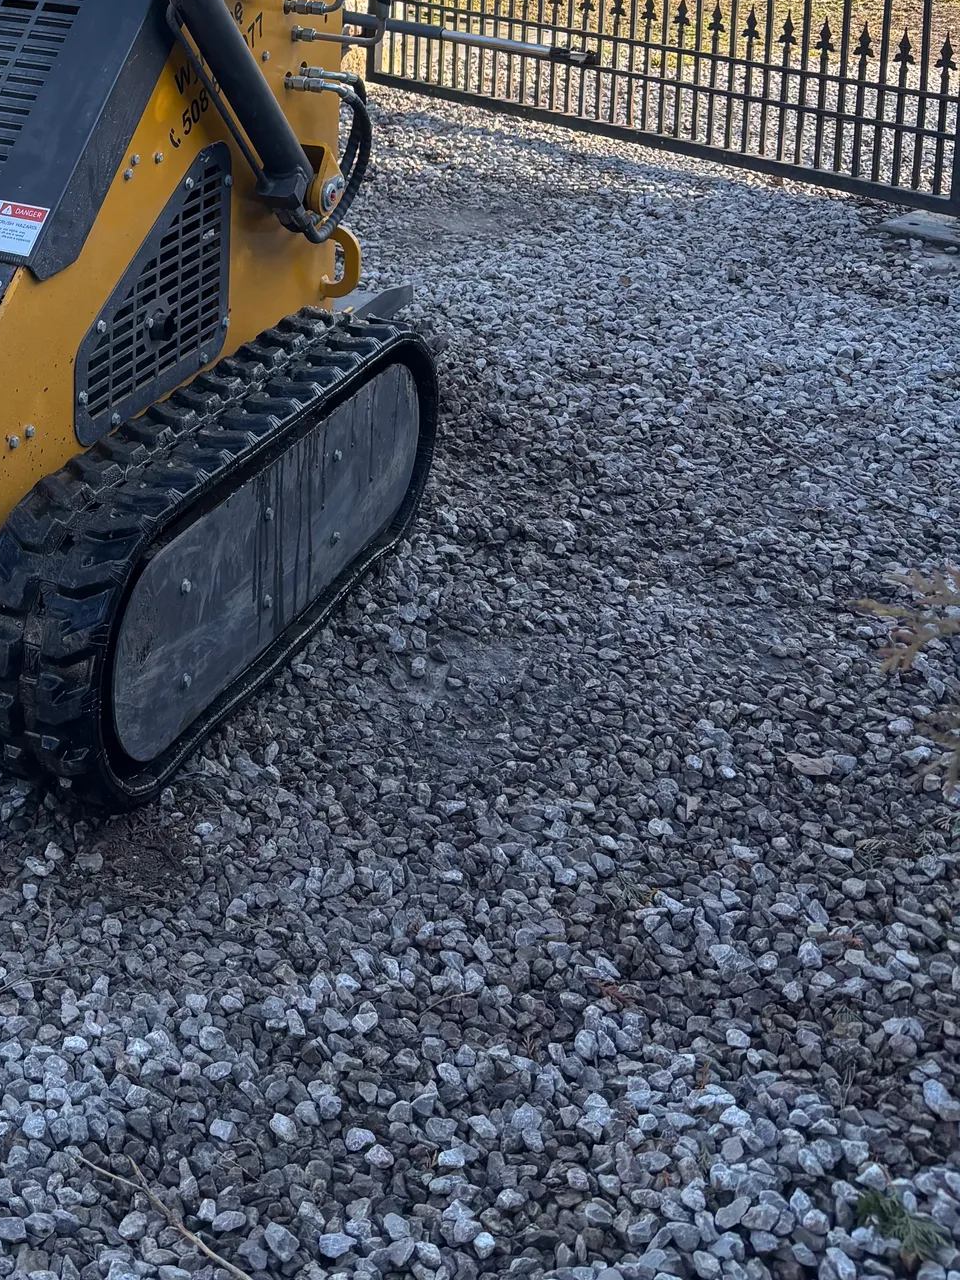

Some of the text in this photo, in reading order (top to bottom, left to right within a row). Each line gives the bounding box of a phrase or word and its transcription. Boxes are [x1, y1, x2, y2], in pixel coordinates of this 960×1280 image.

[182, 88, 209, 136] 508
[241, 11, 263, 49] 77
[14, 207, 43, 218] DANGER
